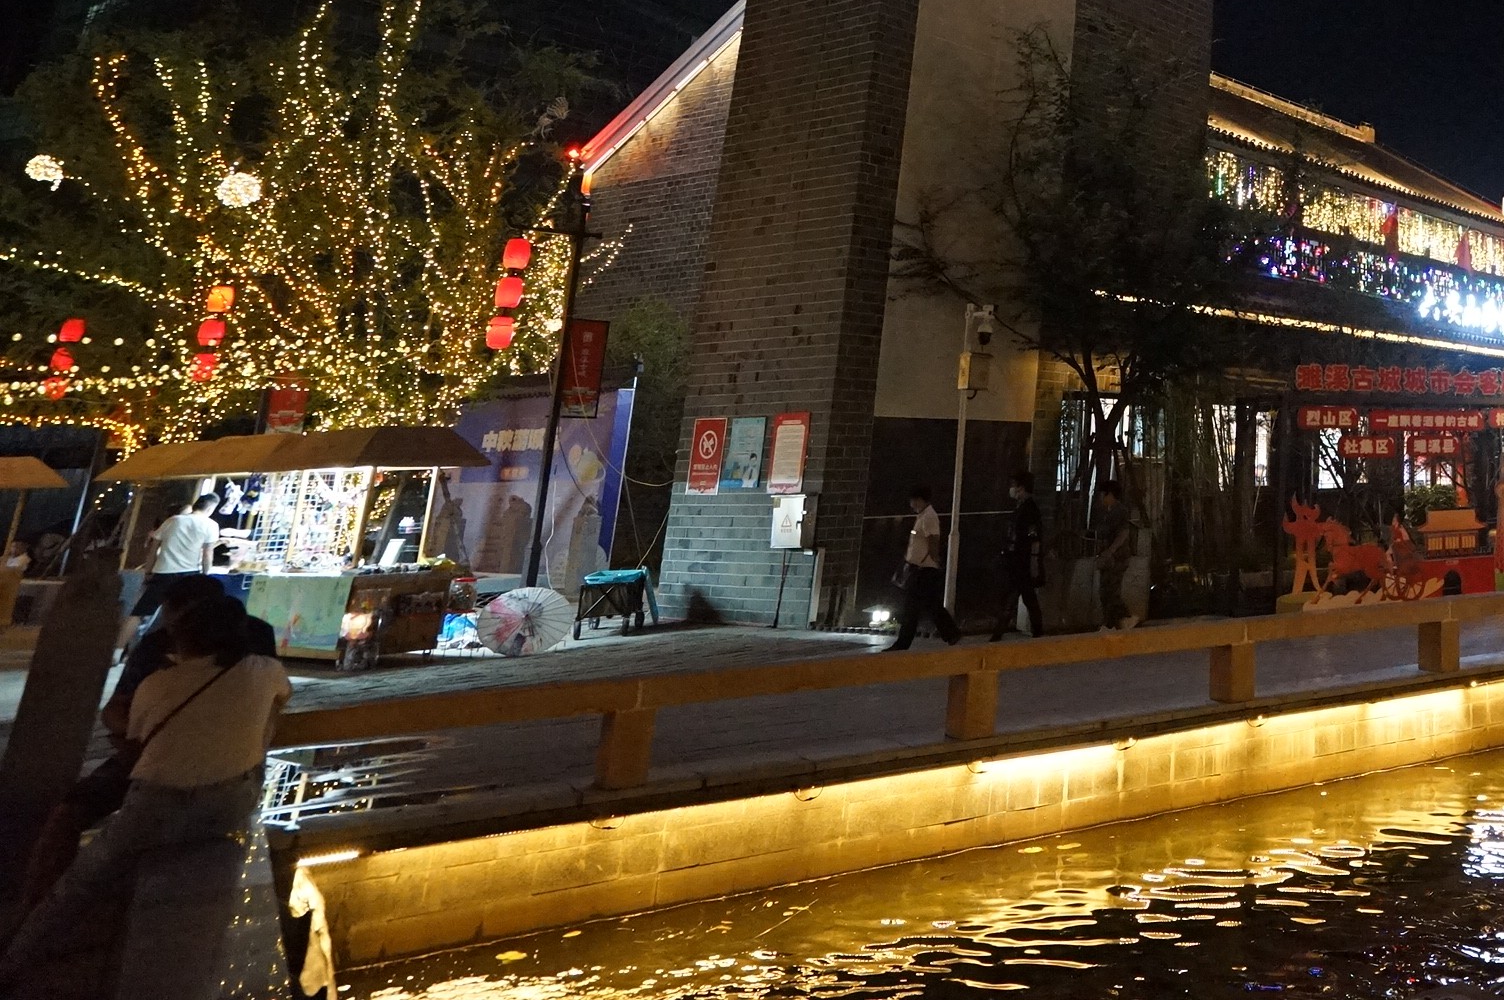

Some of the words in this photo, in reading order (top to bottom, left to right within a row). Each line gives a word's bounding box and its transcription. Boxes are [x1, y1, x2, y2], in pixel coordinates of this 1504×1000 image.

[1306, 410, 1352, 426] 烈山区
[1343, 438, 1388, 455] 杜集区
